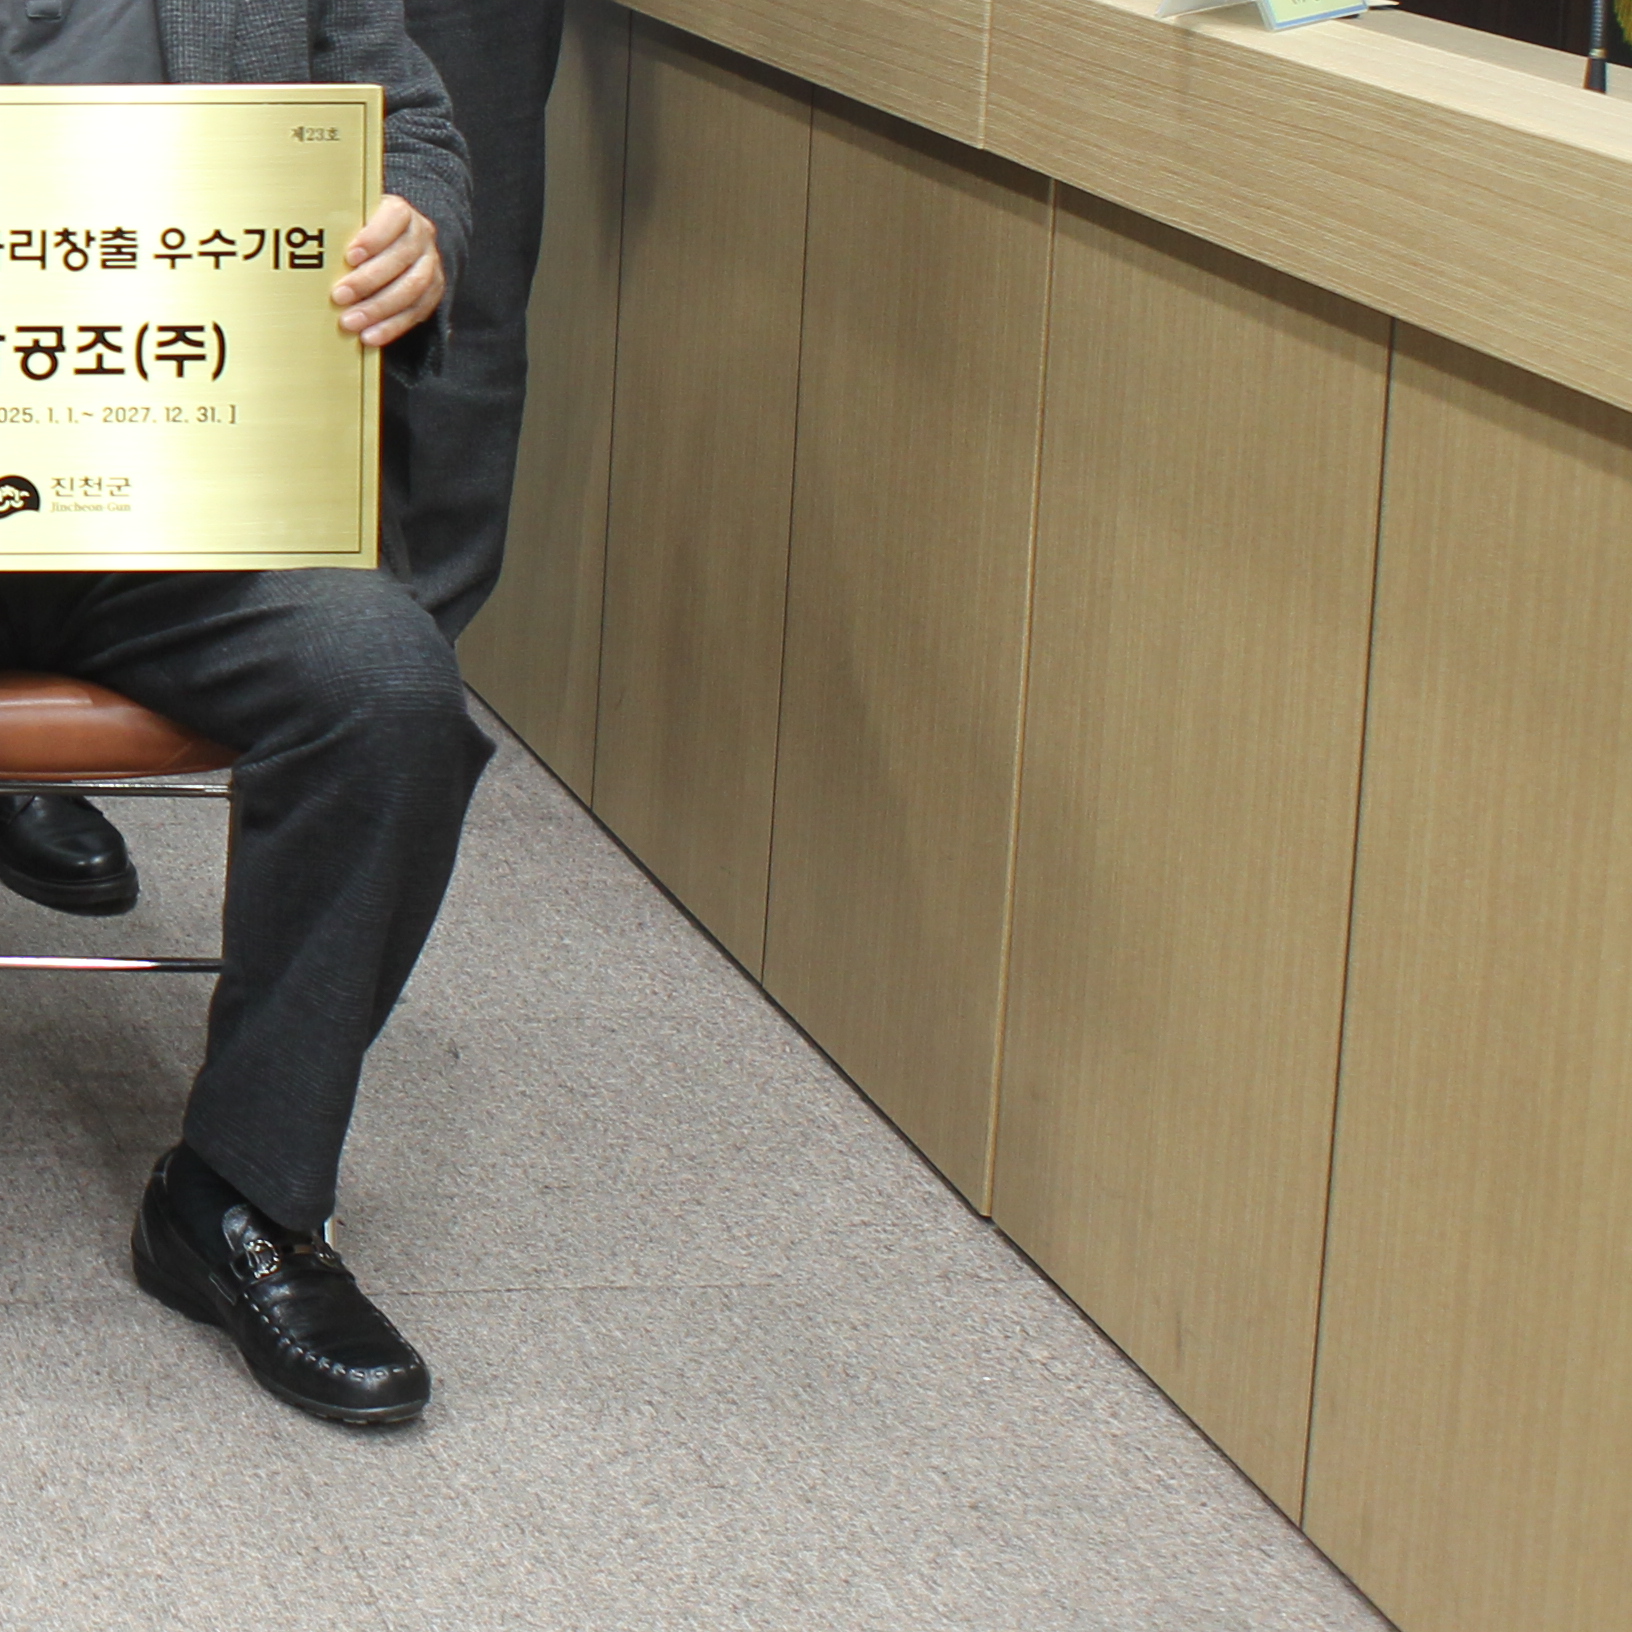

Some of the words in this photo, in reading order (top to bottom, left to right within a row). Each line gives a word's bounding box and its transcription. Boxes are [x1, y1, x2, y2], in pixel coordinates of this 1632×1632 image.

[291, 125, 340, 143] 제23호
[154, 227, 326, 271] 우수기업
[102, 407, 157, 424] 2027.
[165, 407, 189, 424] 12.
[197, 406, 222, 424] 31.
[50, 476, 131, 497] 진천군
